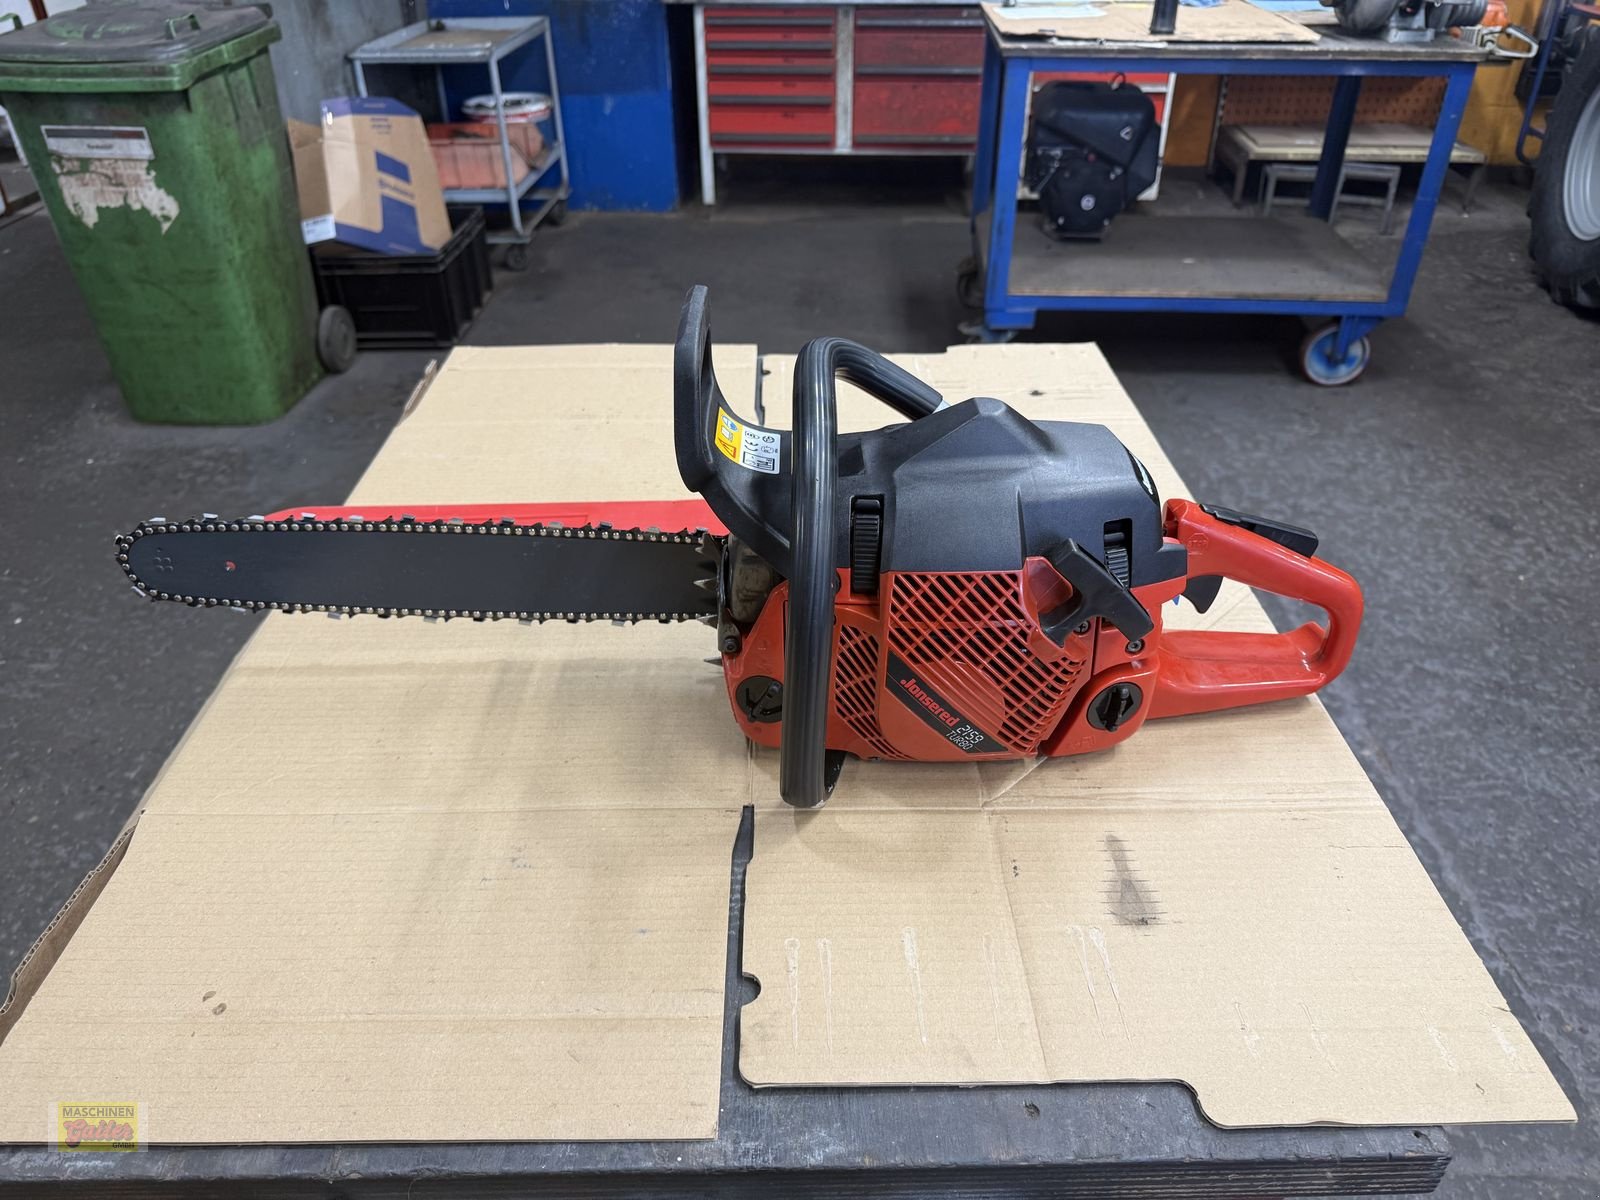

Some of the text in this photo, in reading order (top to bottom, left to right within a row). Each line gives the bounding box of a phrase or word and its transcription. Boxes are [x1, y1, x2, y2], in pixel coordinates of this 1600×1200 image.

[900, 678, 960, 727] Jonsered
[946, 730, 973, 750] TURBO
[956, 724, 984, 744] 2159
